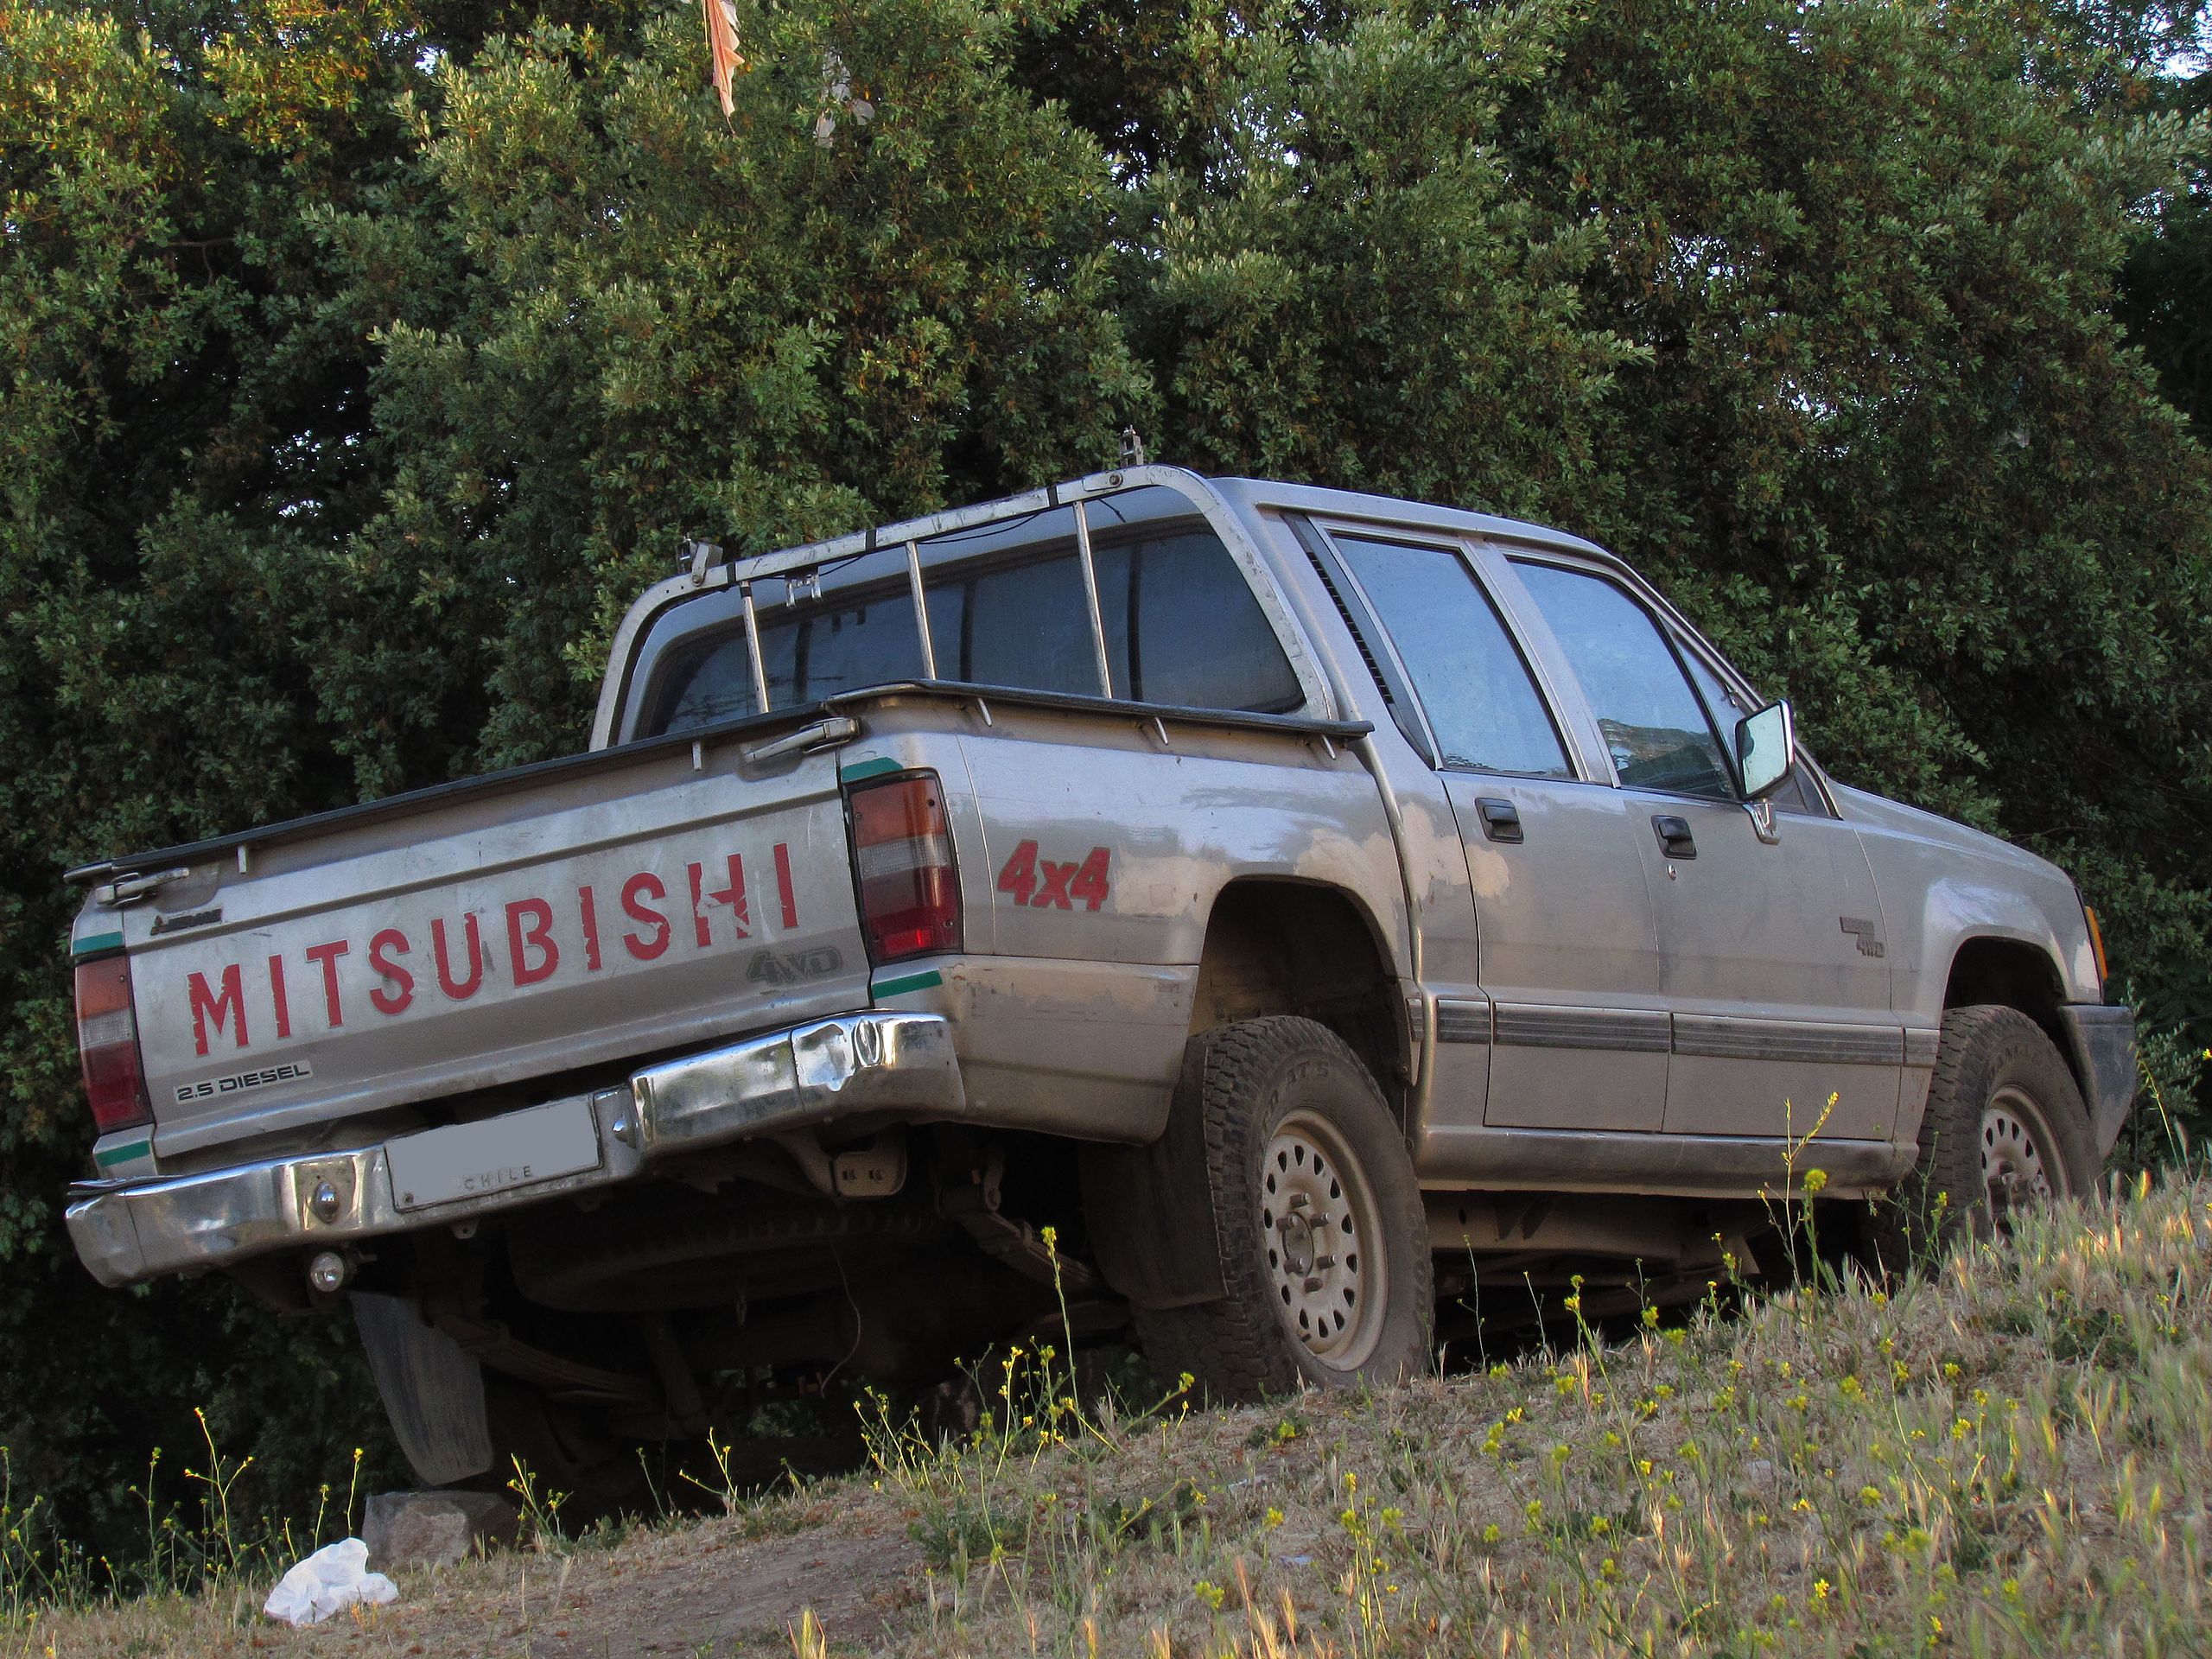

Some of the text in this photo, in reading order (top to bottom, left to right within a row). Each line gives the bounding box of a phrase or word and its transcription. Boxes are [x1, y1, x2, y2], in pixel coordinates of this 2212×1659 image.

[997, 840, 1111, 912] 4x4
[188, 842, 798, 1057] MITSUBISHI
[176, 1064, 311, 1102] 2.5 DIESEL
[463, 1164, 534, 1191] CHILE
